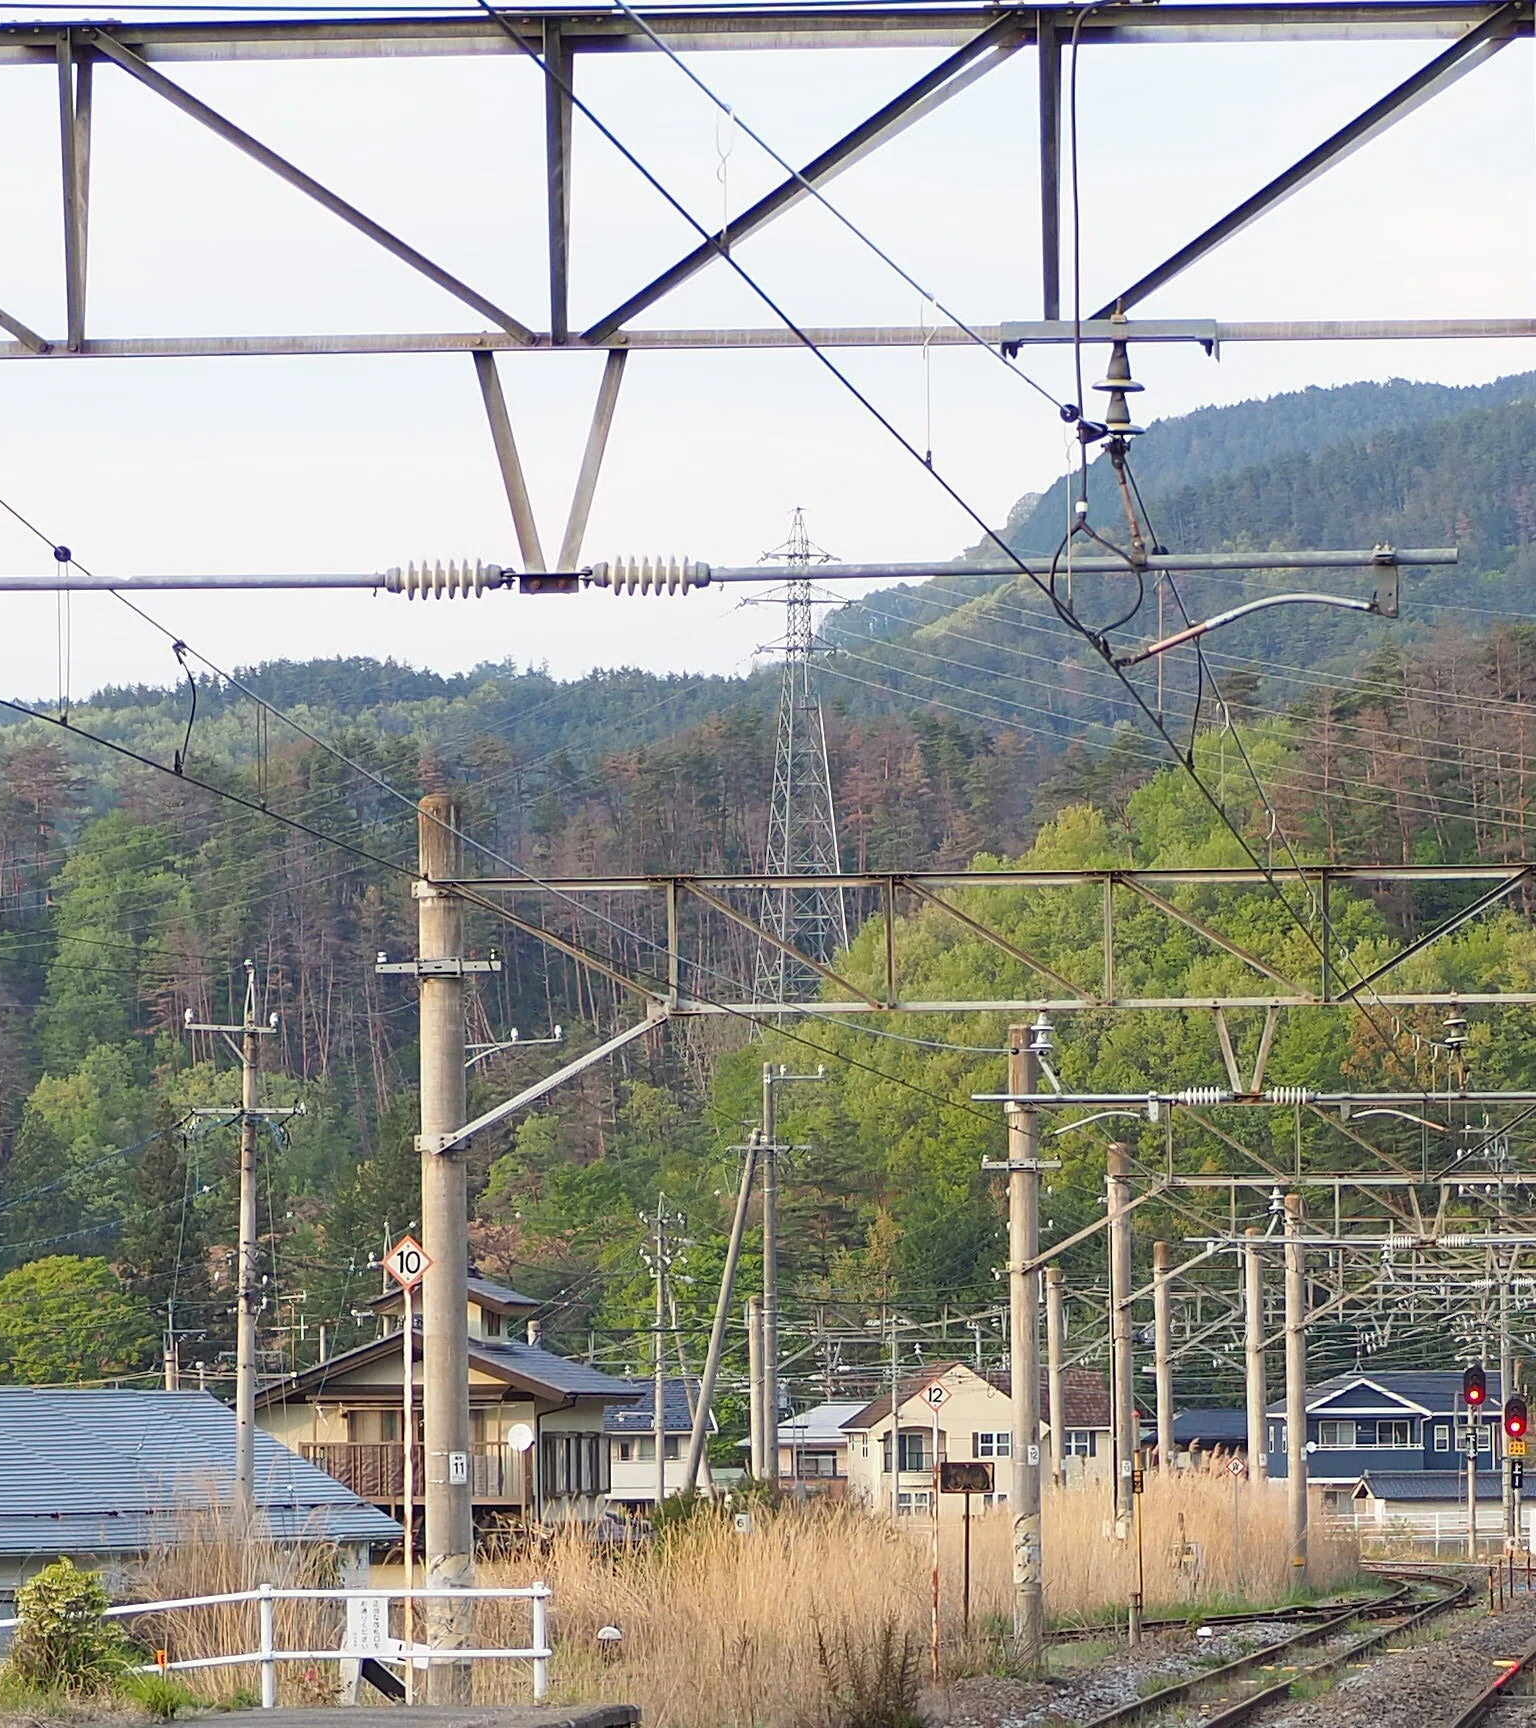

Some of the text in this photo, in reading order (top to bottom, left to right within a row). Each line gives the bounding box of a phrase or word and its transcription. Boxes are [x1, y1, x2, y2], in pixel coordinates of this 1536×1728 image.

[397, 1250, 420, 1274] 10
[928, 1387, 943, 1403] 12
[454, 1462, 464, 1475] 11
[737, 1519, 744, 1527] 6
